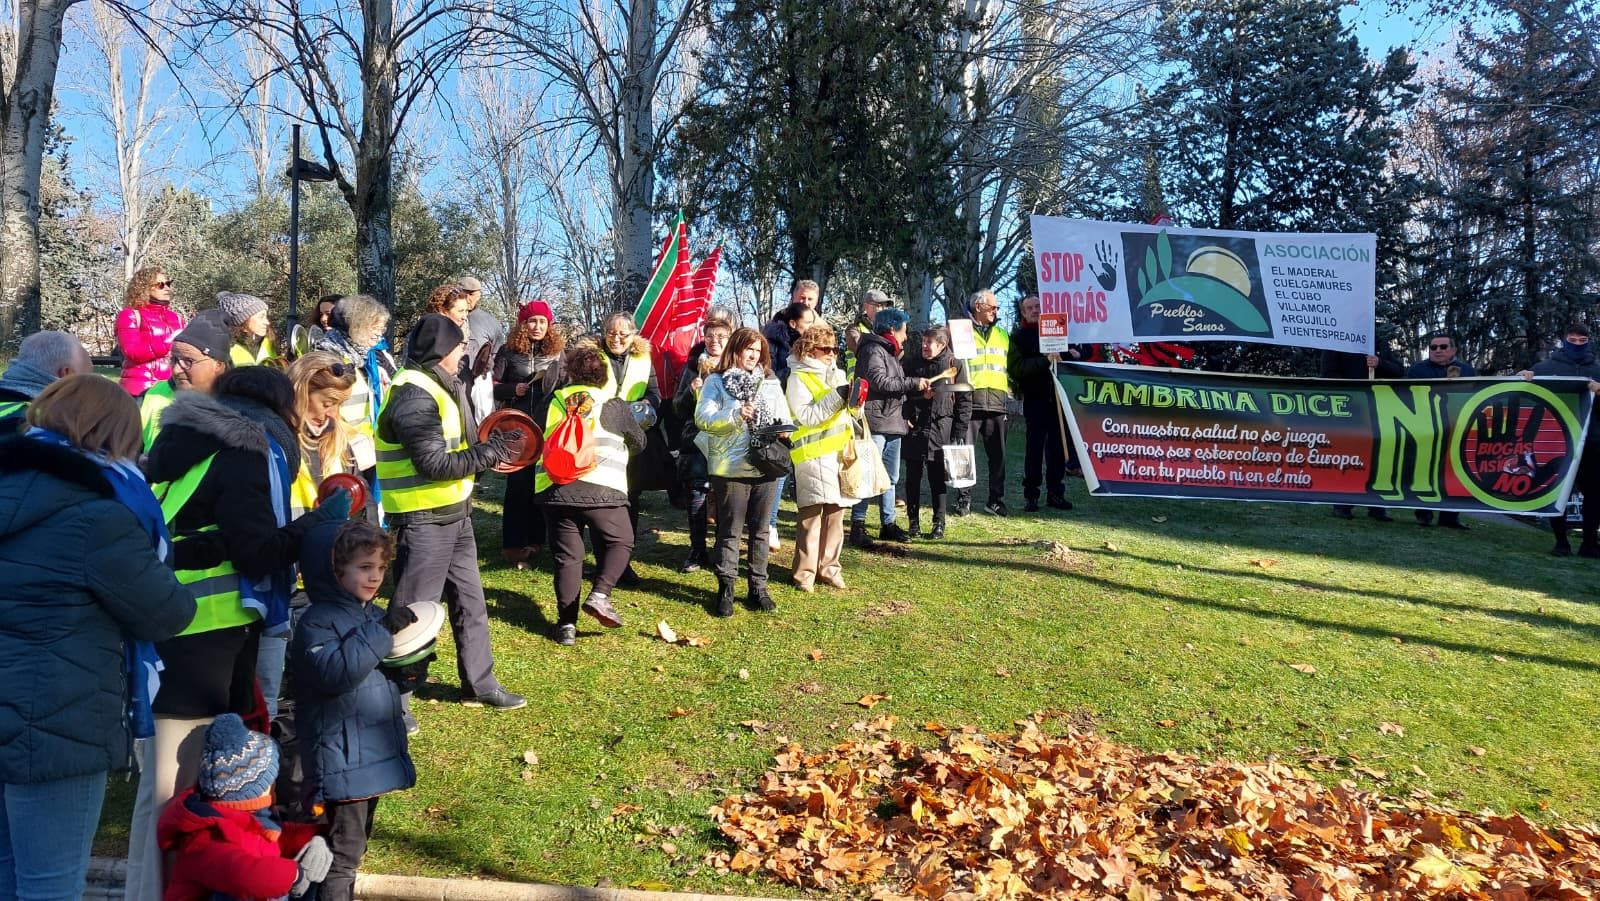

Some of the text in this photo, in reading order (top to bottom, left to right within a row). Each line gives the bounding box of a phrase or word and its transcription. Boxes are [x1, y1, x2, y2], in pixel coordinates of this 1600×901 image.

[1264, 243, 1370, 263] ASOCIACIÓN
[1041, 252, 1084, 283] STOP
[1271, 266, 1338, 279] EL MADERAL
[1273, 278, 1353, 292] CUELGAMURES
[1275, 290, 1321, 301] EL CUBO
[1042, 286, 1108, 324] BIOGÁS
[1150, 303, 1205, 318] Pueblos
[1278, 302, 1332, 314] VILLAMOR
[1042, 320, 1057, 328] STOP
[1182, 317, 1226, 332] Sanos
[1281, 314, 1337, 327] ARGUJILLO
[1283, 326, 1367, 344] FUENTESPREADAS
[1078, 380, 1352, 417] JAMBRINA DICE
[1102, 417, 1330, 448] Con nuestra salud no se juega.
[1477, 437, 1533, 456] BIOGÁS
[1092, 442, 1165, 458] queremos
[1166, 445, 1192, 458] ser
[1194, 443, 1282, 463] estercolero
[1285, 447, 1305, 463] de
[1307, 448, 1364, 470] Europa.
[1118, 459, 1312, 484] Ni en tu pueblo ni en el mío
[1492, 473, 1532, 496] NO
